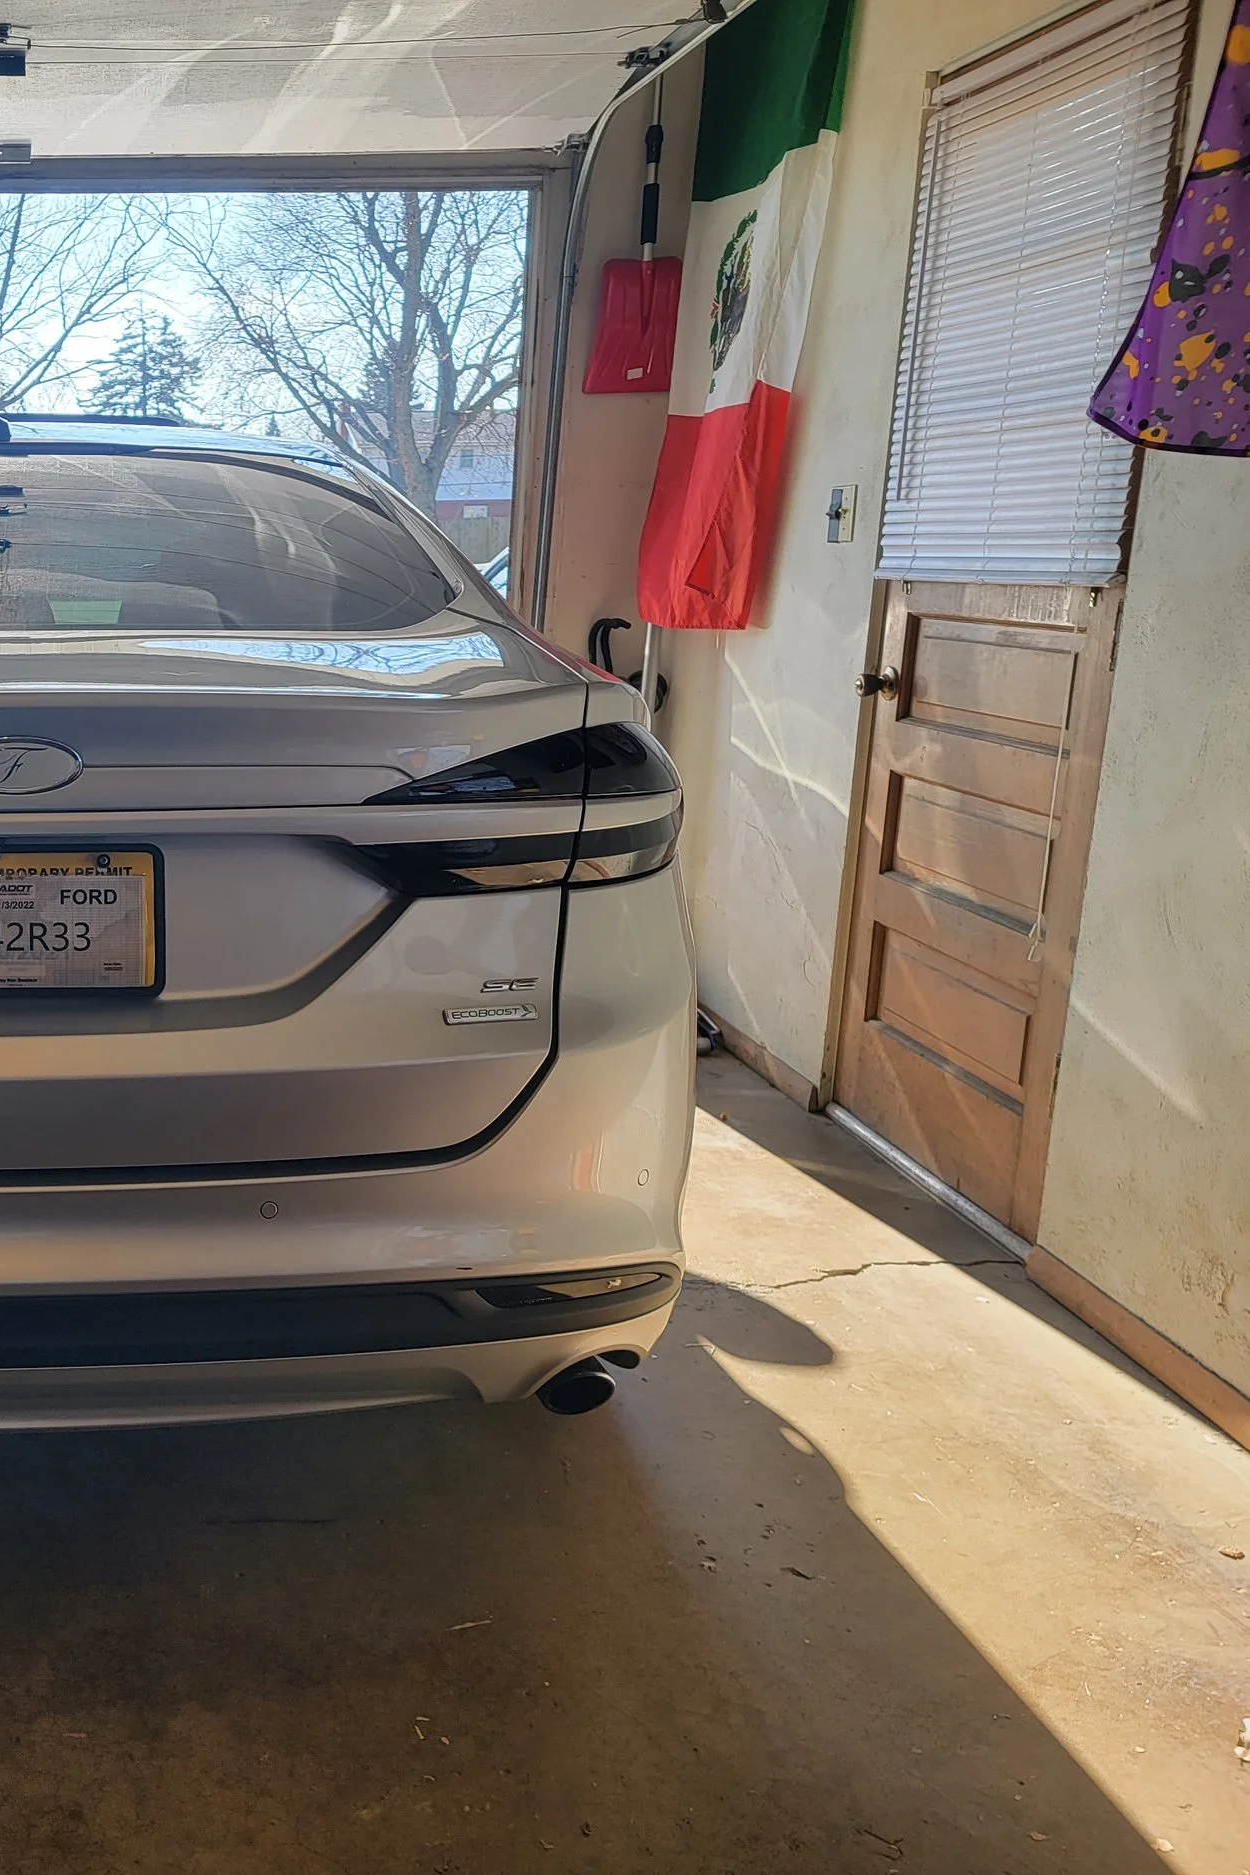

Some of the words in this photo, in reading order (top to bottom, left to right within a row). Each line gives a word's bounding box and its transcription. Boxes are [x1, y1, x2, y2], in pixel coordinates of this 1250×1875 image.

[60, 889, 118, 905] FORD
[480, 977, 539, 994] SE
[451, 1007, 520, 1020] ECOBOOST
